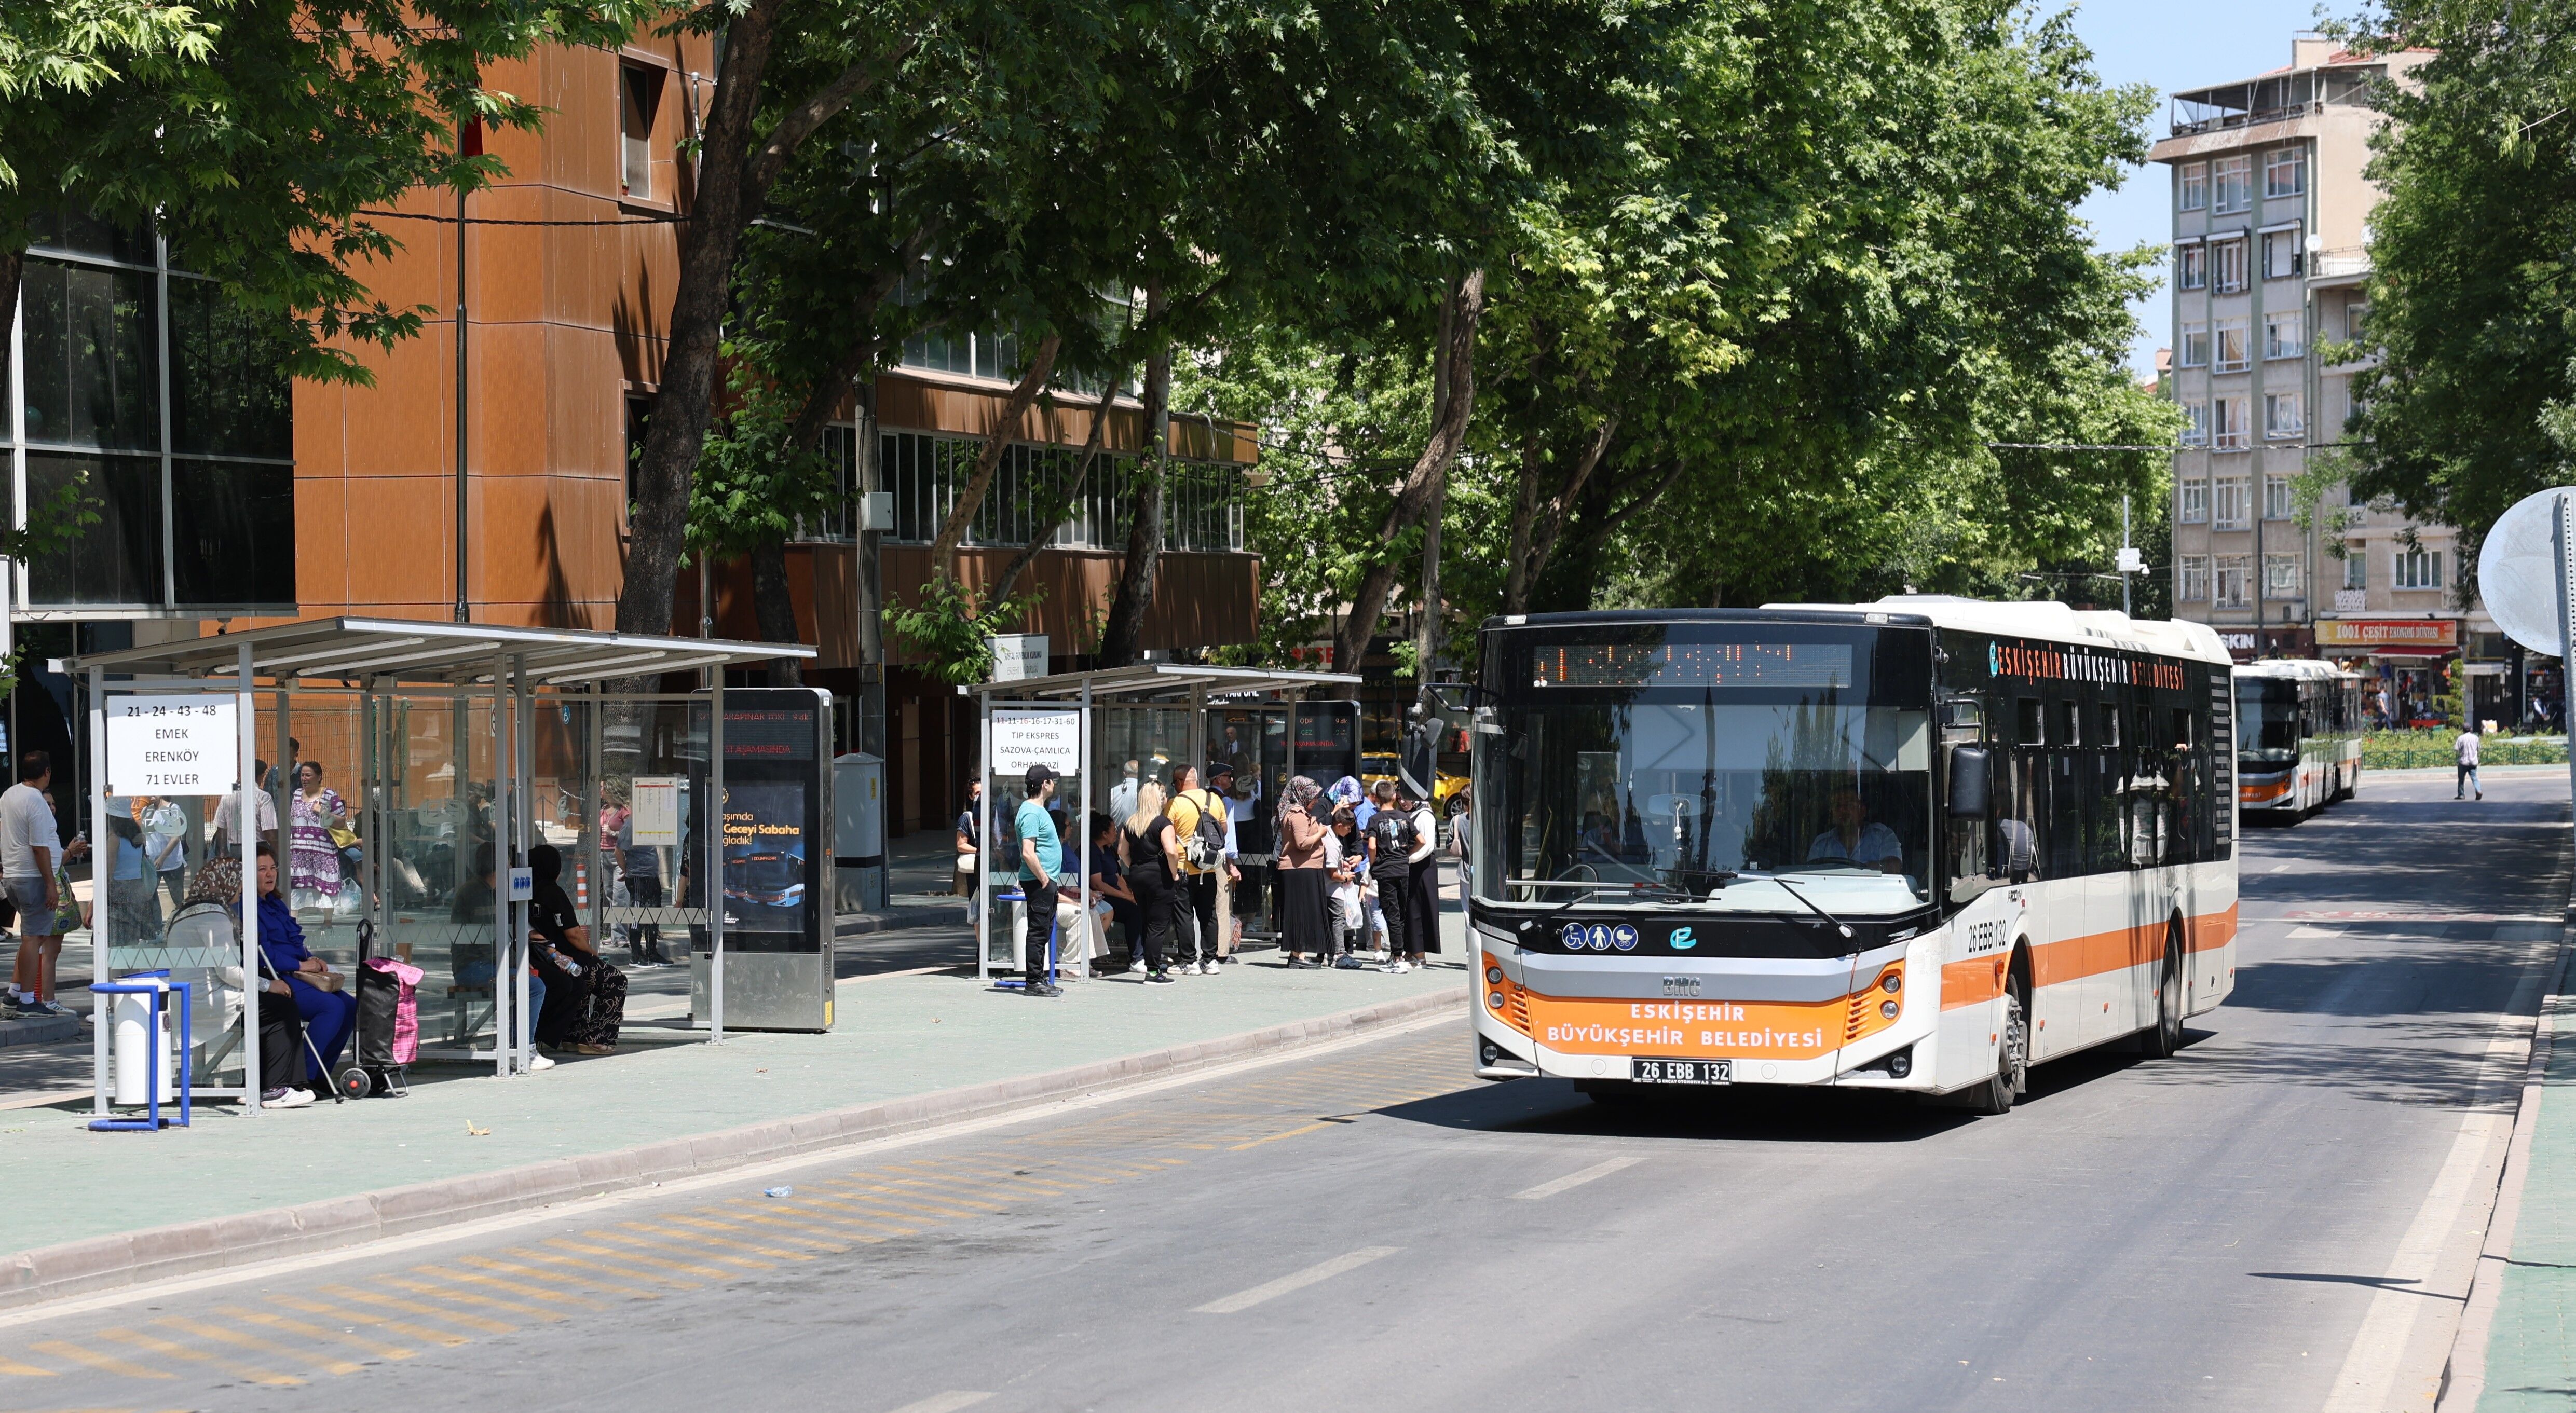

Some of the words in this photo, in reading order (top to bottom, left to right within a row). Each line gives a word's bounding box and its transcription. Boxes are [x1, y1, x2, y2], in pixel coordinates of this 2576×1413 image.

[2336, 624, 2360, 639] 1001
[2363, 623, 2388, 642] ÇEŞİT
[2390, 623, 2415, 638] EKONOMİ
[2416, 623, 2438, 638] DÜNYASI
[1998, 639, 2061, 685] ESKİŞEHİR
[2063, 646, 2128, 691] BÜYÜKŞEHİR
[2132, 656, 2184, 690] BELEDİYESİ
[128, 706, 141, 717] 21
[153, 706, 166, 716] 24
[177, 705, 191, 716] 43
[202, 705, 216, 716] 48
[156, 729, 188, 739] EMEK
[145, 748, 199, 762] ERENKÖY
[1000, 746, 1070, 755] SAZOVA-ÇAMLICA
[146, 775, 159, 785] 71
[164, 774, 199, 784] EVLER
[723, 812, 753, 822] aşımda
[724, 823, 757, 836] Geceyi
[758, 824, 800, 835] Sabaha
[723, 835, 752, 846] ğladık!
[1968, 924, 1977, 953] 26
[1979, 922, 1993, 951] EBB
[1995, 919, 2006, 948] 132
[1662, 976, 1701, 996] BMC
[1631, 1000, 1744, 1023] ESKİŞEHİR
[1547, 1023, 1683, 1047] BÜYÜKŞEHİR
[1701, 1027, 1822, 1047] BELEDİYESİ
[1642, 1062, 1660, 1078] 26
[1667, 1063, 1694, 1079] EBB
[1703, 1064, 1728, 1080] 132
